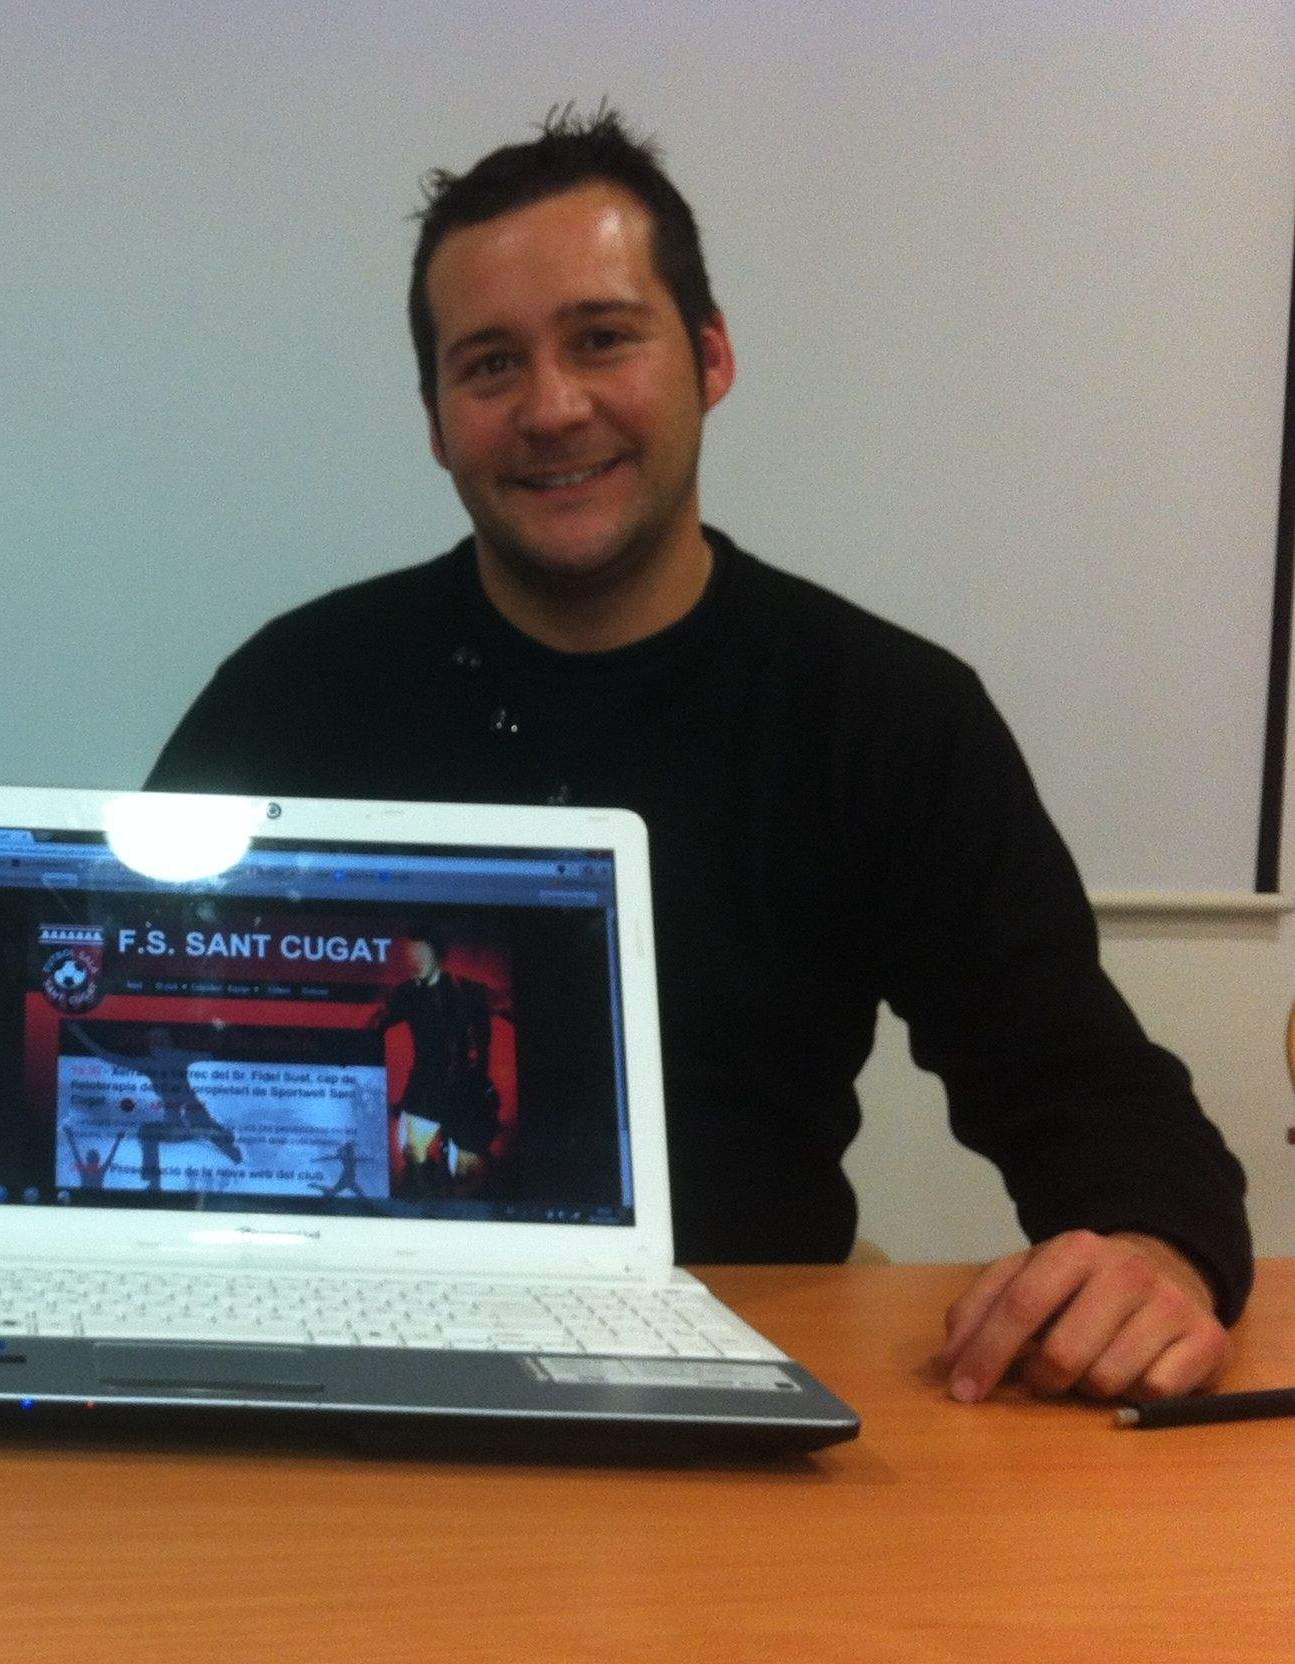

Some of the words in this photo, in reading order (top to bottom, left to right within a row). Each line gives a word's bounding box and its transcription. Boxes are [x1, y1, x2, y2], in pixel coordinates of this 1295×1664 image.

[118, 929, 175, 955] F.S.
[185, 931, 272, 959] SANT
[280, 934, 393, 963] CUGAT
